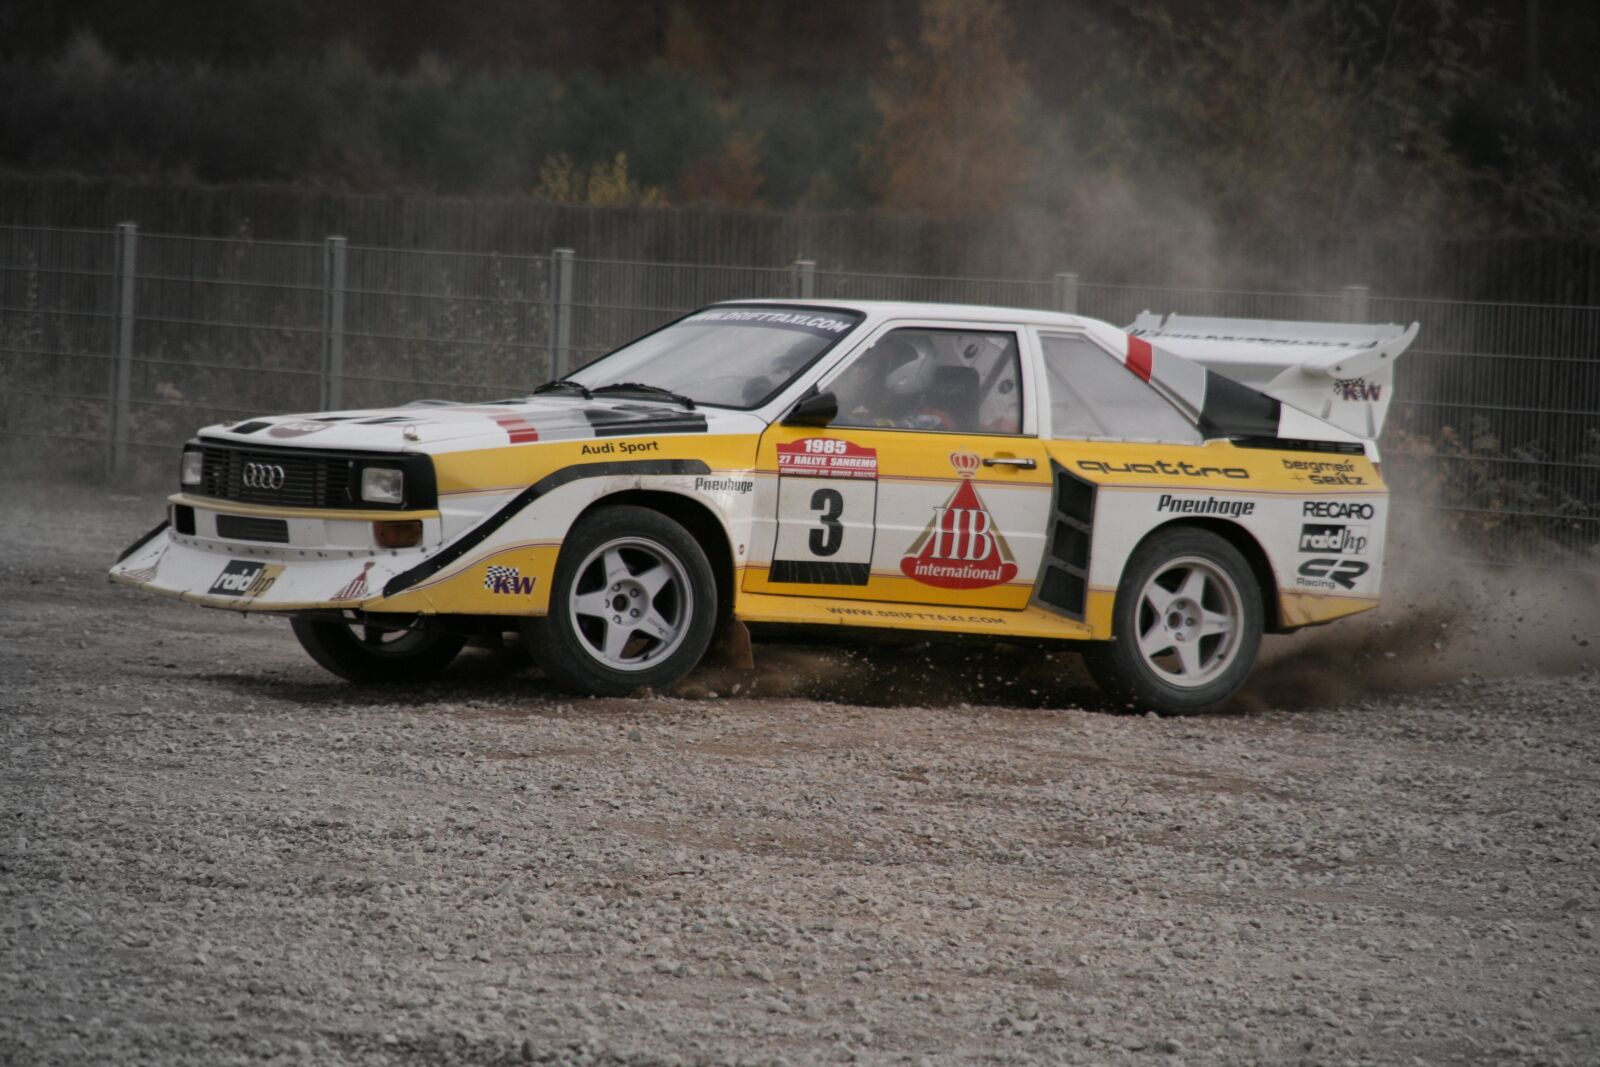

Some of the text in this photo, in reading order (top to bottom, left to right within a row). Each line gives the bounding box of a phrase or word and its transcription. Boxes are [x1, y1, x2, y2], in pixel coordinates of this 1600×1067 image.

[1342, 382, 1381, 401] KW
[581, 441, 659, 455] Audi Sport
[803, 439, 846, 454] 1985
[779, 455, 877, 468] 27 RALLYE SANREMO
[1076, 460, 1250, 479] quattro
[695, 477, 754, 494] Pneuhage
[1308, 471, 1369, 486] seitz
[1157, 495, 1255, 518] Pneuhage
[1302, 501, 1375, 520] RECARO
[809, 488, 844, 557] 3
[928, 506, 993, 561] HB
[1301, 529, 1367, 554] raid hp
[914, 560, 1003, 581] international
[213, 569, 262, 592] raid
[493, 576, 536, 595] KW
[1296, 577, 1336, 590] Racing
[826, 607, 1006, 625] WWW.DRIFTTAXI.COM
